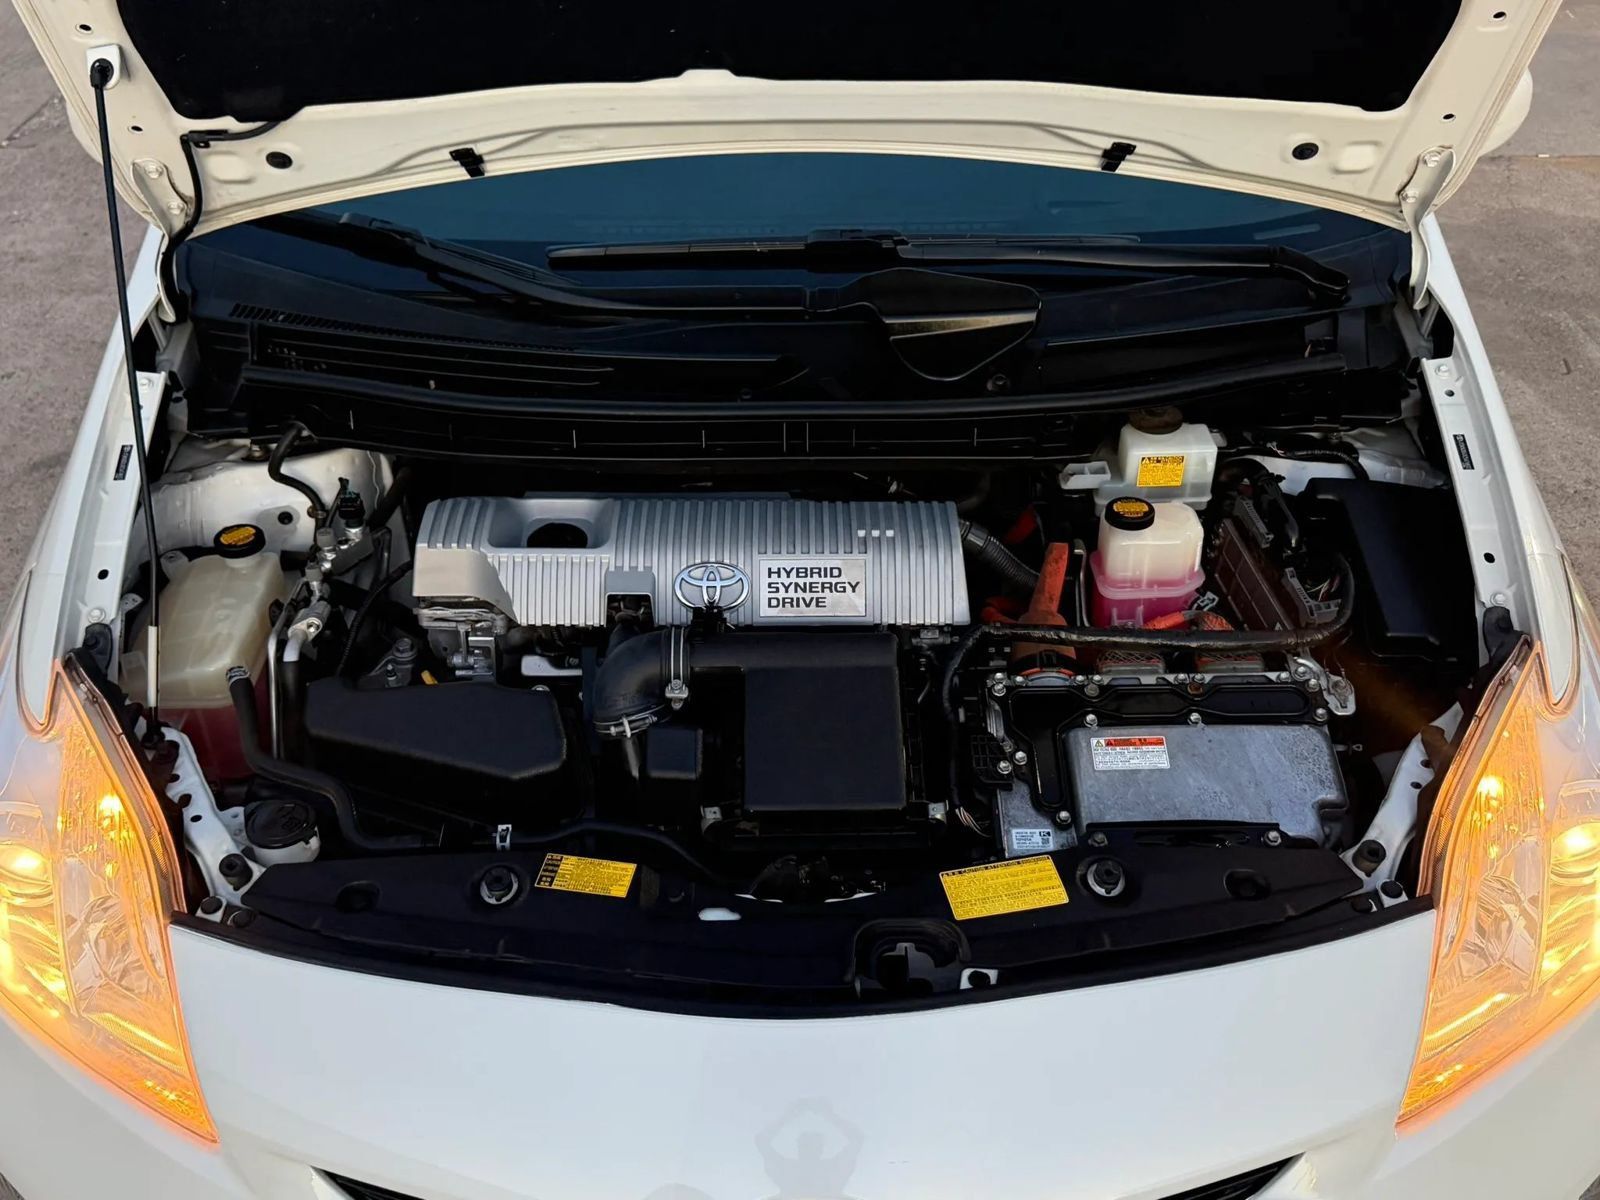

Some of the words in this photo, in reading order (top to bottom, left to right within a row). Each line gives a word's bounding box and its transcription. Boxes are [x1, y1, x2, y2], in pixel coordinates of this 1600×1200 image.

[768, 567, 842, 579] HYBRID
[768, 582, 860, 594] SYNERGY
[768, 597, 827, 608] DRIVE
